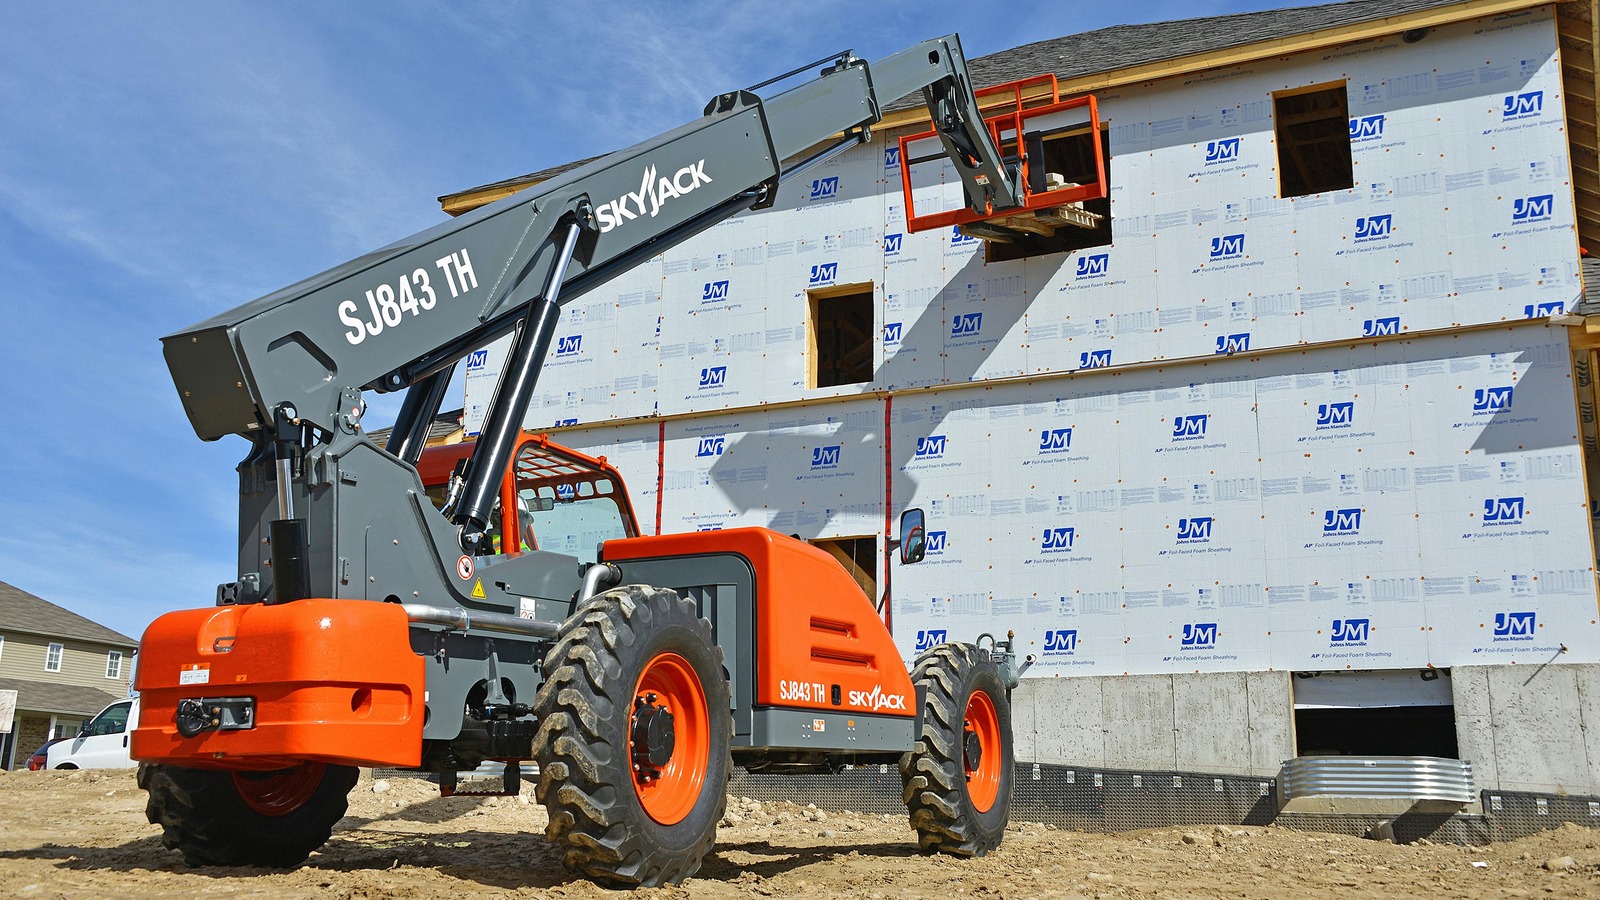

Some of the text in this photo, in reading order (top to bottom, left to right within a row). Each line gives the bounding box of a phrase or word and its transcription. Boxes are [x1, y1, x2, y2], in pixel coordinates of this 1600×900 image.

[1503, 91, 1543, 116] JM
[1206, 138, 1240, 161] JM
[595, 159, 713, 233] SKYJACK
[811, 177, 838, 197] JM
[1513, 194, 1553, 219] JM
[1355, 214, 1391, 238] JM
[1210, 234, 1244, 256] JM
[1388, 241, 1413, 250] Sheathing
[810, 263, 838, 283] JM
[1076, 254, 1108, 276] JM
[1240, 260, 1264, 268] Sheathing
[338, 248, 479, 345] SJ843 TH
[703, 280, 729, 300] JM
[952, 313, 982, 333] JM
[557, 335, 582, 354] JM
[700, 366, 726, 385] JM
[1474, 387, 1513, 410] JM
[1317, 402, 1353, 424] JM
[1173, 415, 1207, 436] JM
[916, 435, 946, 456] JM
[1040, 428, 1072, 449] JM
[812, 446, 840, 465] JM
[1484, 497, 1524, 520] JM
[1177, 518, 1212, 539] JM
[1324, 509, 1361, 531] JM
[1042, 528, 1074, 548] JM
[1182, 623, 1217, 645] JM
[1331, 619, 1369, 641] JM
[1494, 612, 1535, 636] JM
[1044, 630, 1077, 650] JM
[780, 680, 825, 703] SJ843 TH
[849, 684, 906, 710] SKYJACK
